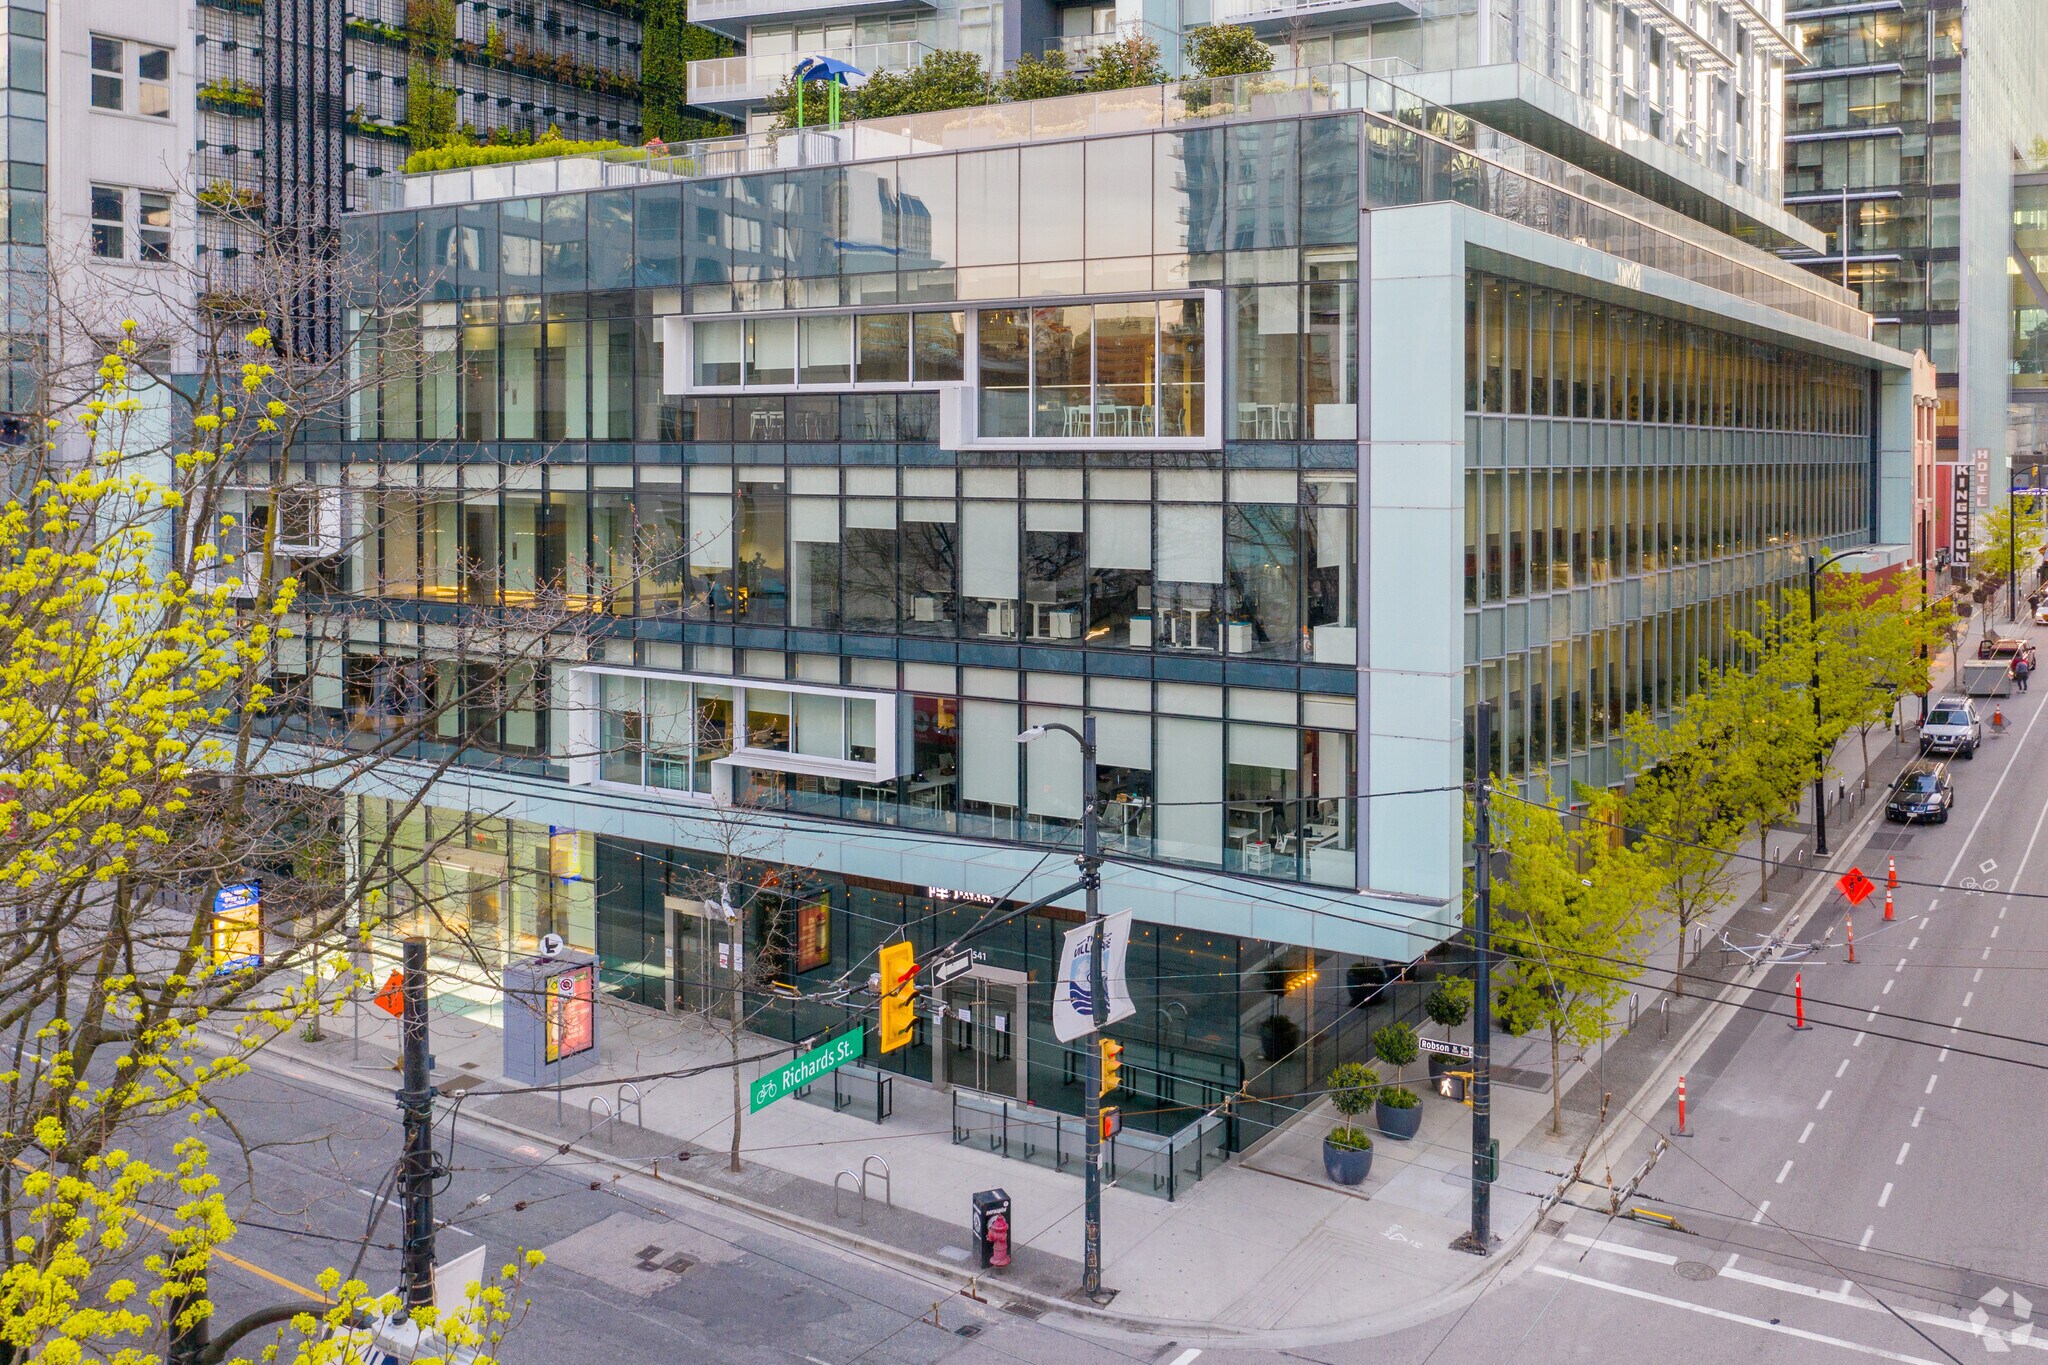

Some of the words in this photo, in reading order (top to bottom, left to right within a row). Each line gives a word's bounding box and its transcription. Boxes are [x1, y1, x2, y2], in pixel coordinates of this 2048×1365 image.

[1977, 449, 1988, 507] HOTEL
[1956, 465, 1969, 562] KINGSTON
[782, 1049, 834, 1090] Richards
[837, 1041, 853, 1061] St.
[1421, 1040, 1449, 1052] Robson
